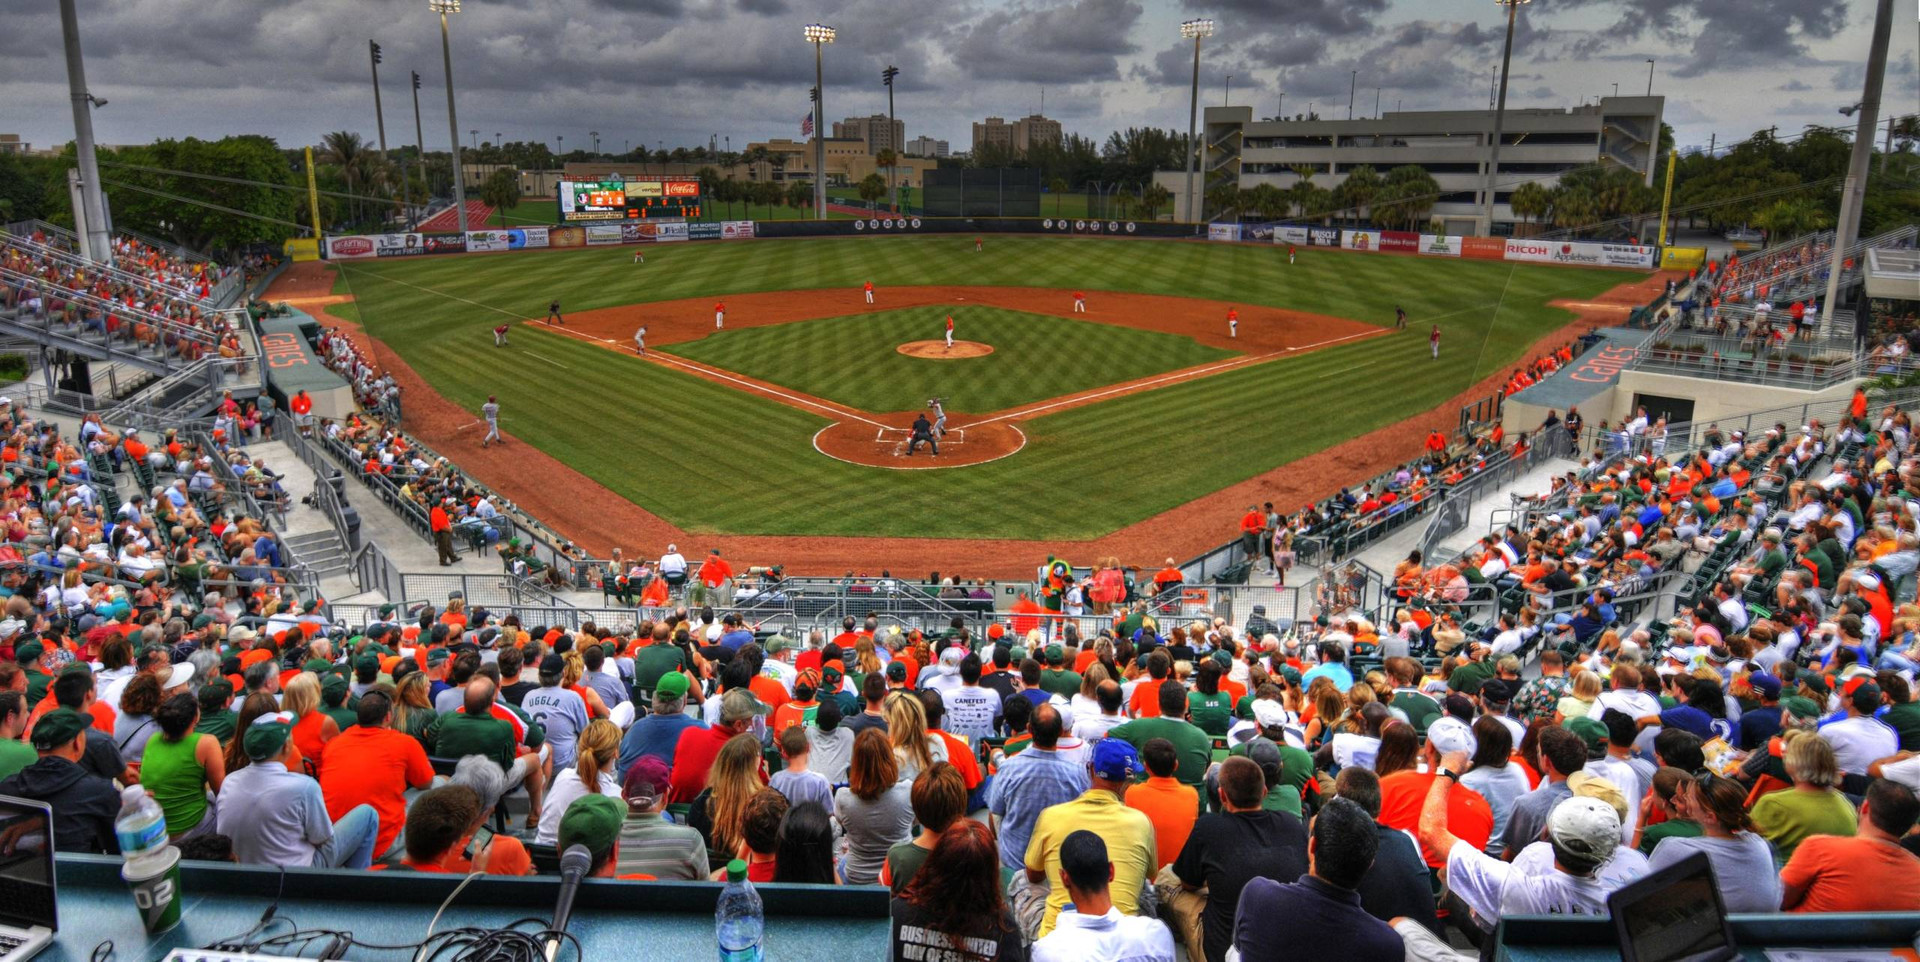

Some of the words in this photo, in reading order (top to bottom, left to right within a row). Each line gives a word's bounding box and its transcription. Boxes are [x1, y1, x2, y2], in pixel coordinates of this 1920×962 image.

[670, 183, 696, 194] Coca-Cola
[1311, 229, 1337, 239] MUSCLE
[1315, 238, 1331, 246] MILK
[378, 248, 393, 256] Safe
[1507, 244, 1548, 255] RICOH
[529, 695, 561, 707] UGGLA
[903, 942, 926, 961] DAY
[926, 947, 942, 962] OF
